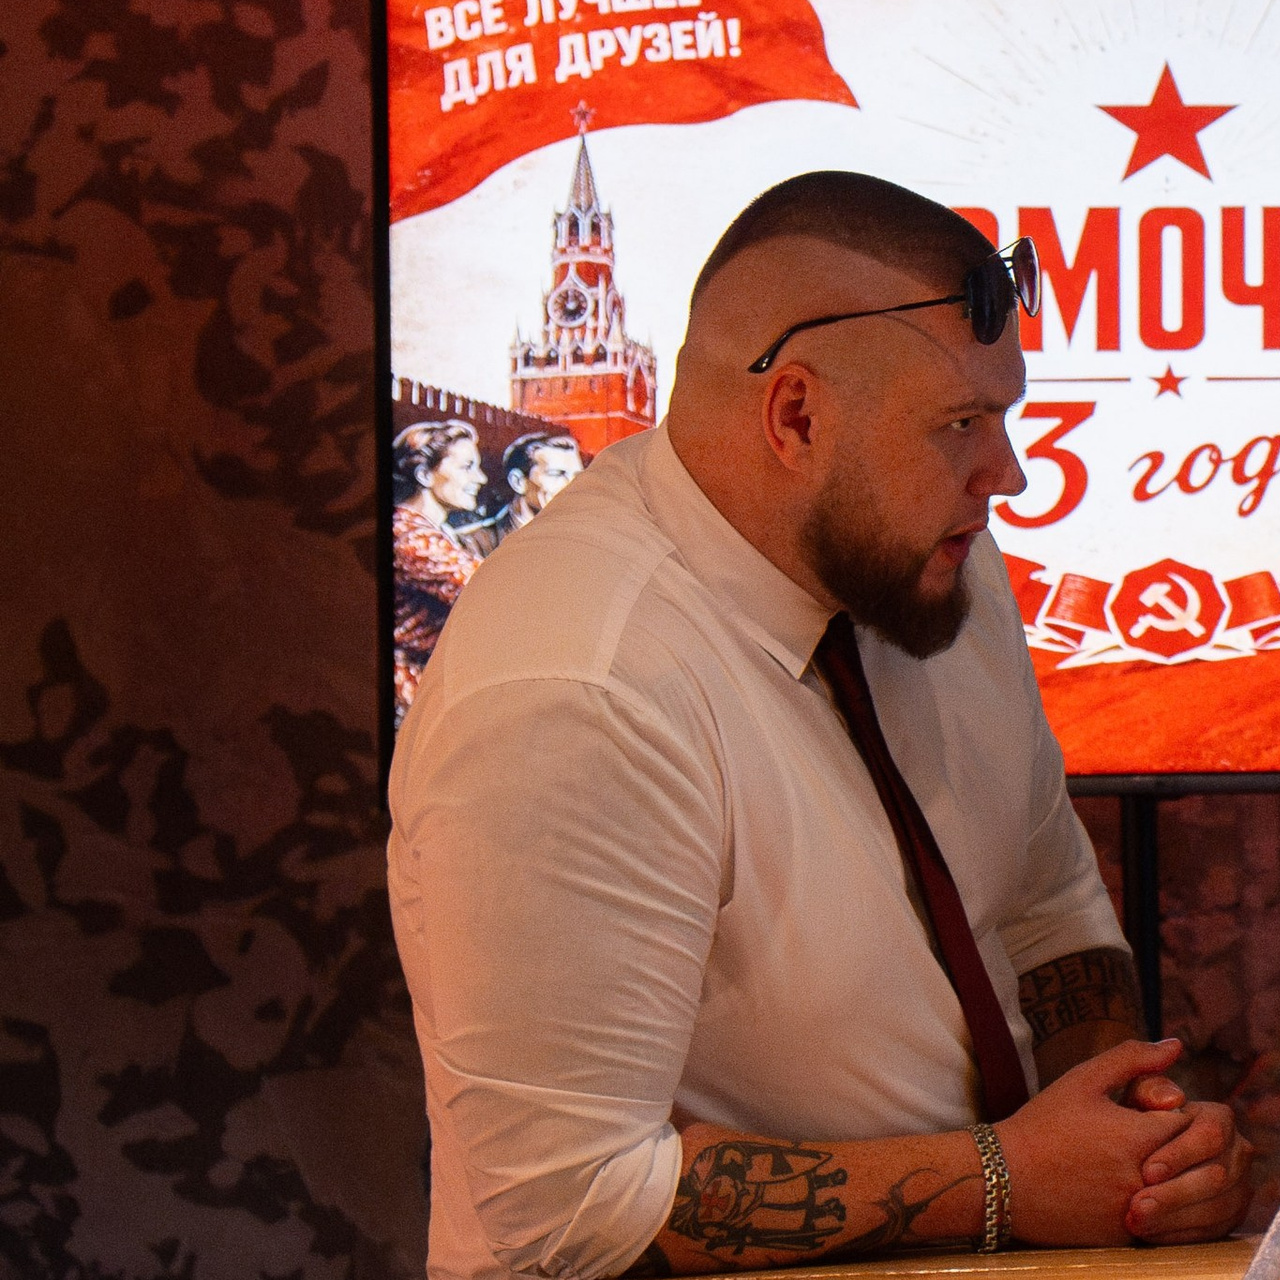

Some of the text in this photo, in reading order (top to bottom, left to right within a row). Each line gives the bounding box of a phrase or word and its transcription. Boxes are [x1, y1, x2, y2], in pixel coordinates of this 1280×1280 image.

[440, 12, 743, 113] ДЛЯ ДРУЗЕЙ!
[994, 400, 1098, 529] 3
